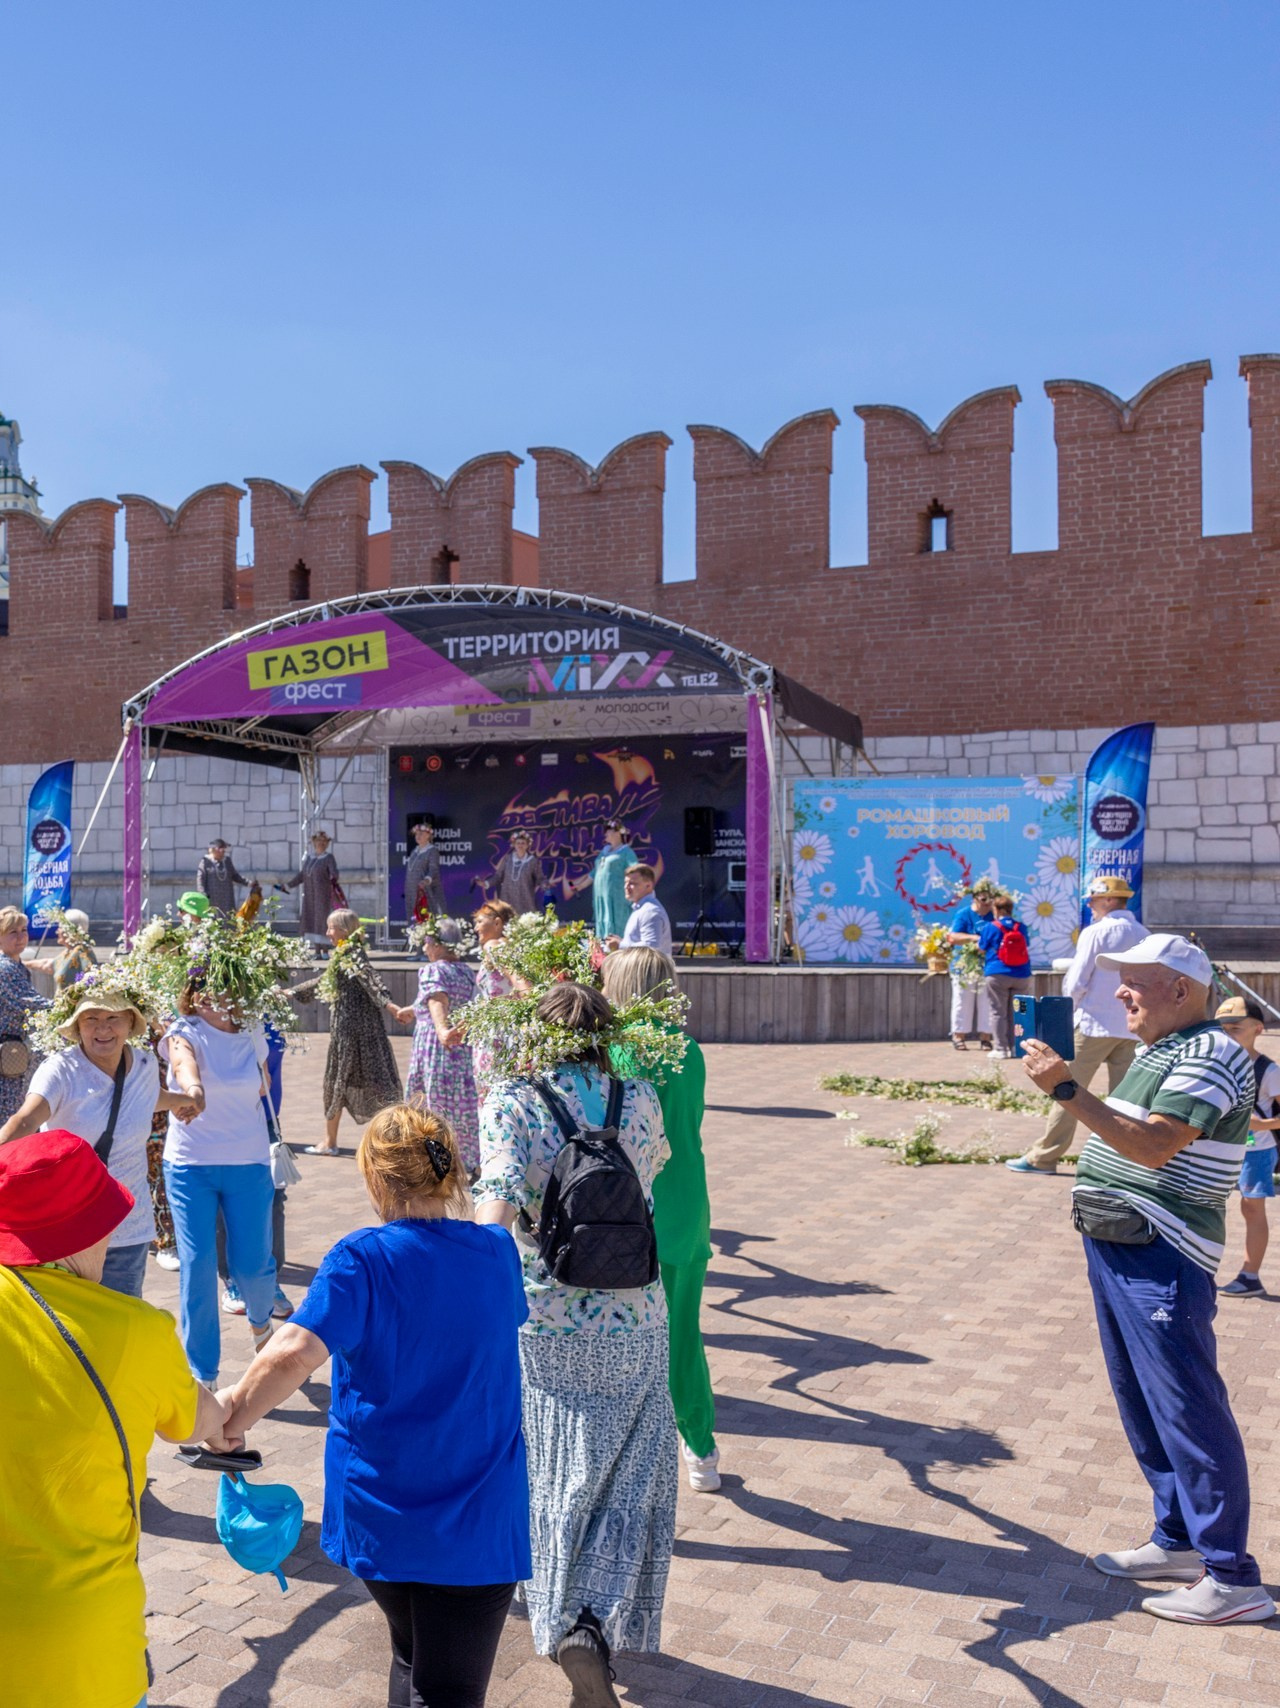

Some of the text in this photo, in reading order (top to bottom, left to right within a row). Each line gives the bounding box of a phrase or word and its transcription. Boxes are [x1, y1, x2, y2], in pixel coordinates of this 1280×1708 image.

[443, 627, 620, 659] ТЕРРИТОРИЯ
[264, 640, 370, 680] ГАЗОН
[681, 671, 719, 687] TELE2
[284, 682, 347, 705] фест
[595, 701, 670, 714] МОЛОДОСТИ
[477, 710, 520, 726] фест
[856, 804, 1010, 823] РОМАШКОВЫЙ
[885, 823, 986, 841] ХОРОВОД
[1087, 848, 1140, 866] СЕВЕРНАЯ
